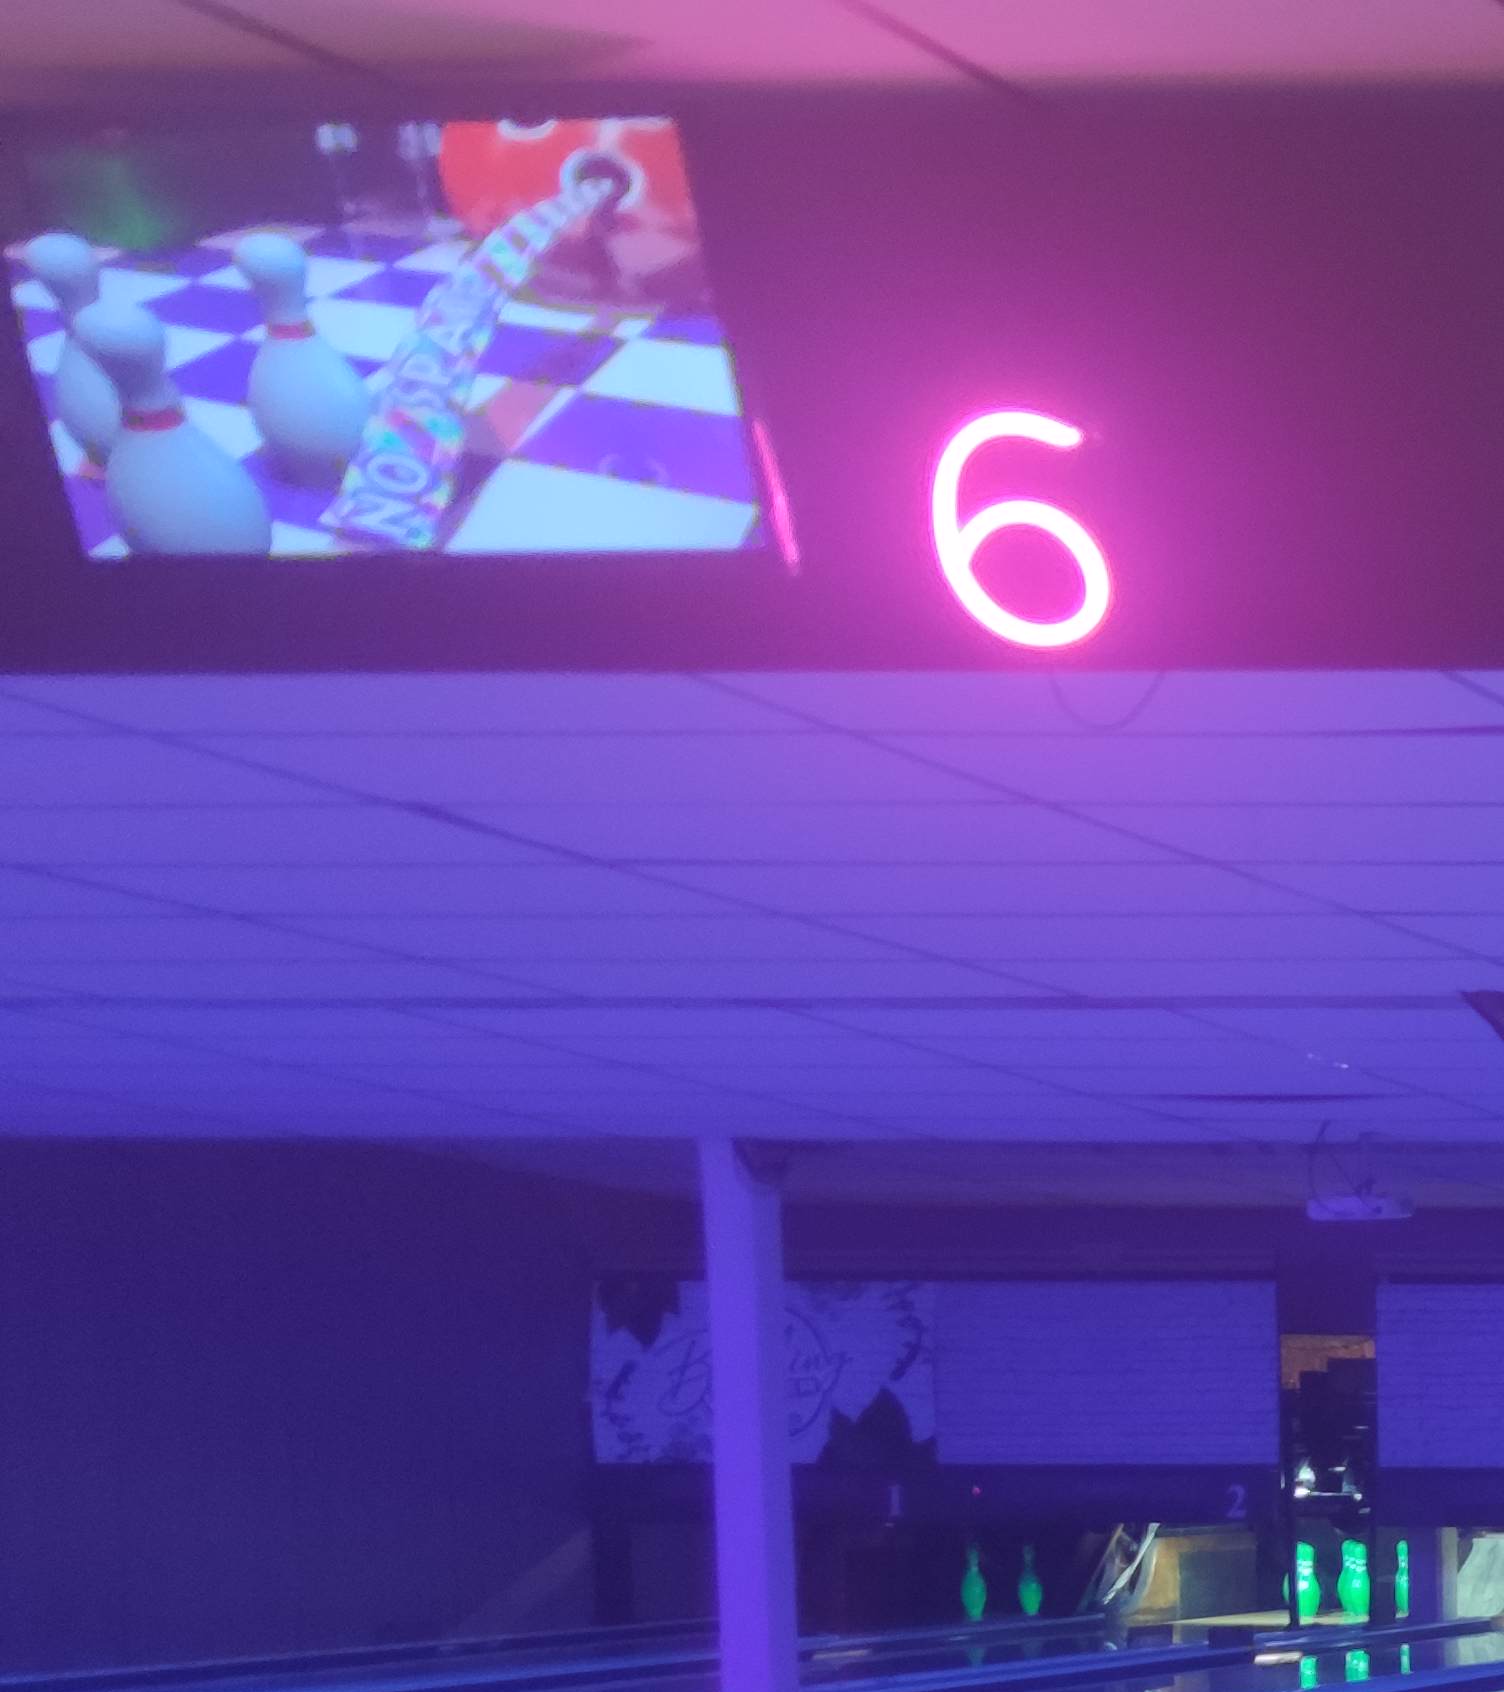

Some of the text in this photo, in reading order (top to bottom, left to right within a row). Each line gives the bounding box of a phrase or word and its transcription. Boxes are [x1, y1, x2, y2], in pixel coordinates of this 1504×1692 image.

[931, 411, 1110, 647] 6
[887, 1483, 904, 1518] 1
[1226, 1484, 1248, 1519] 2
